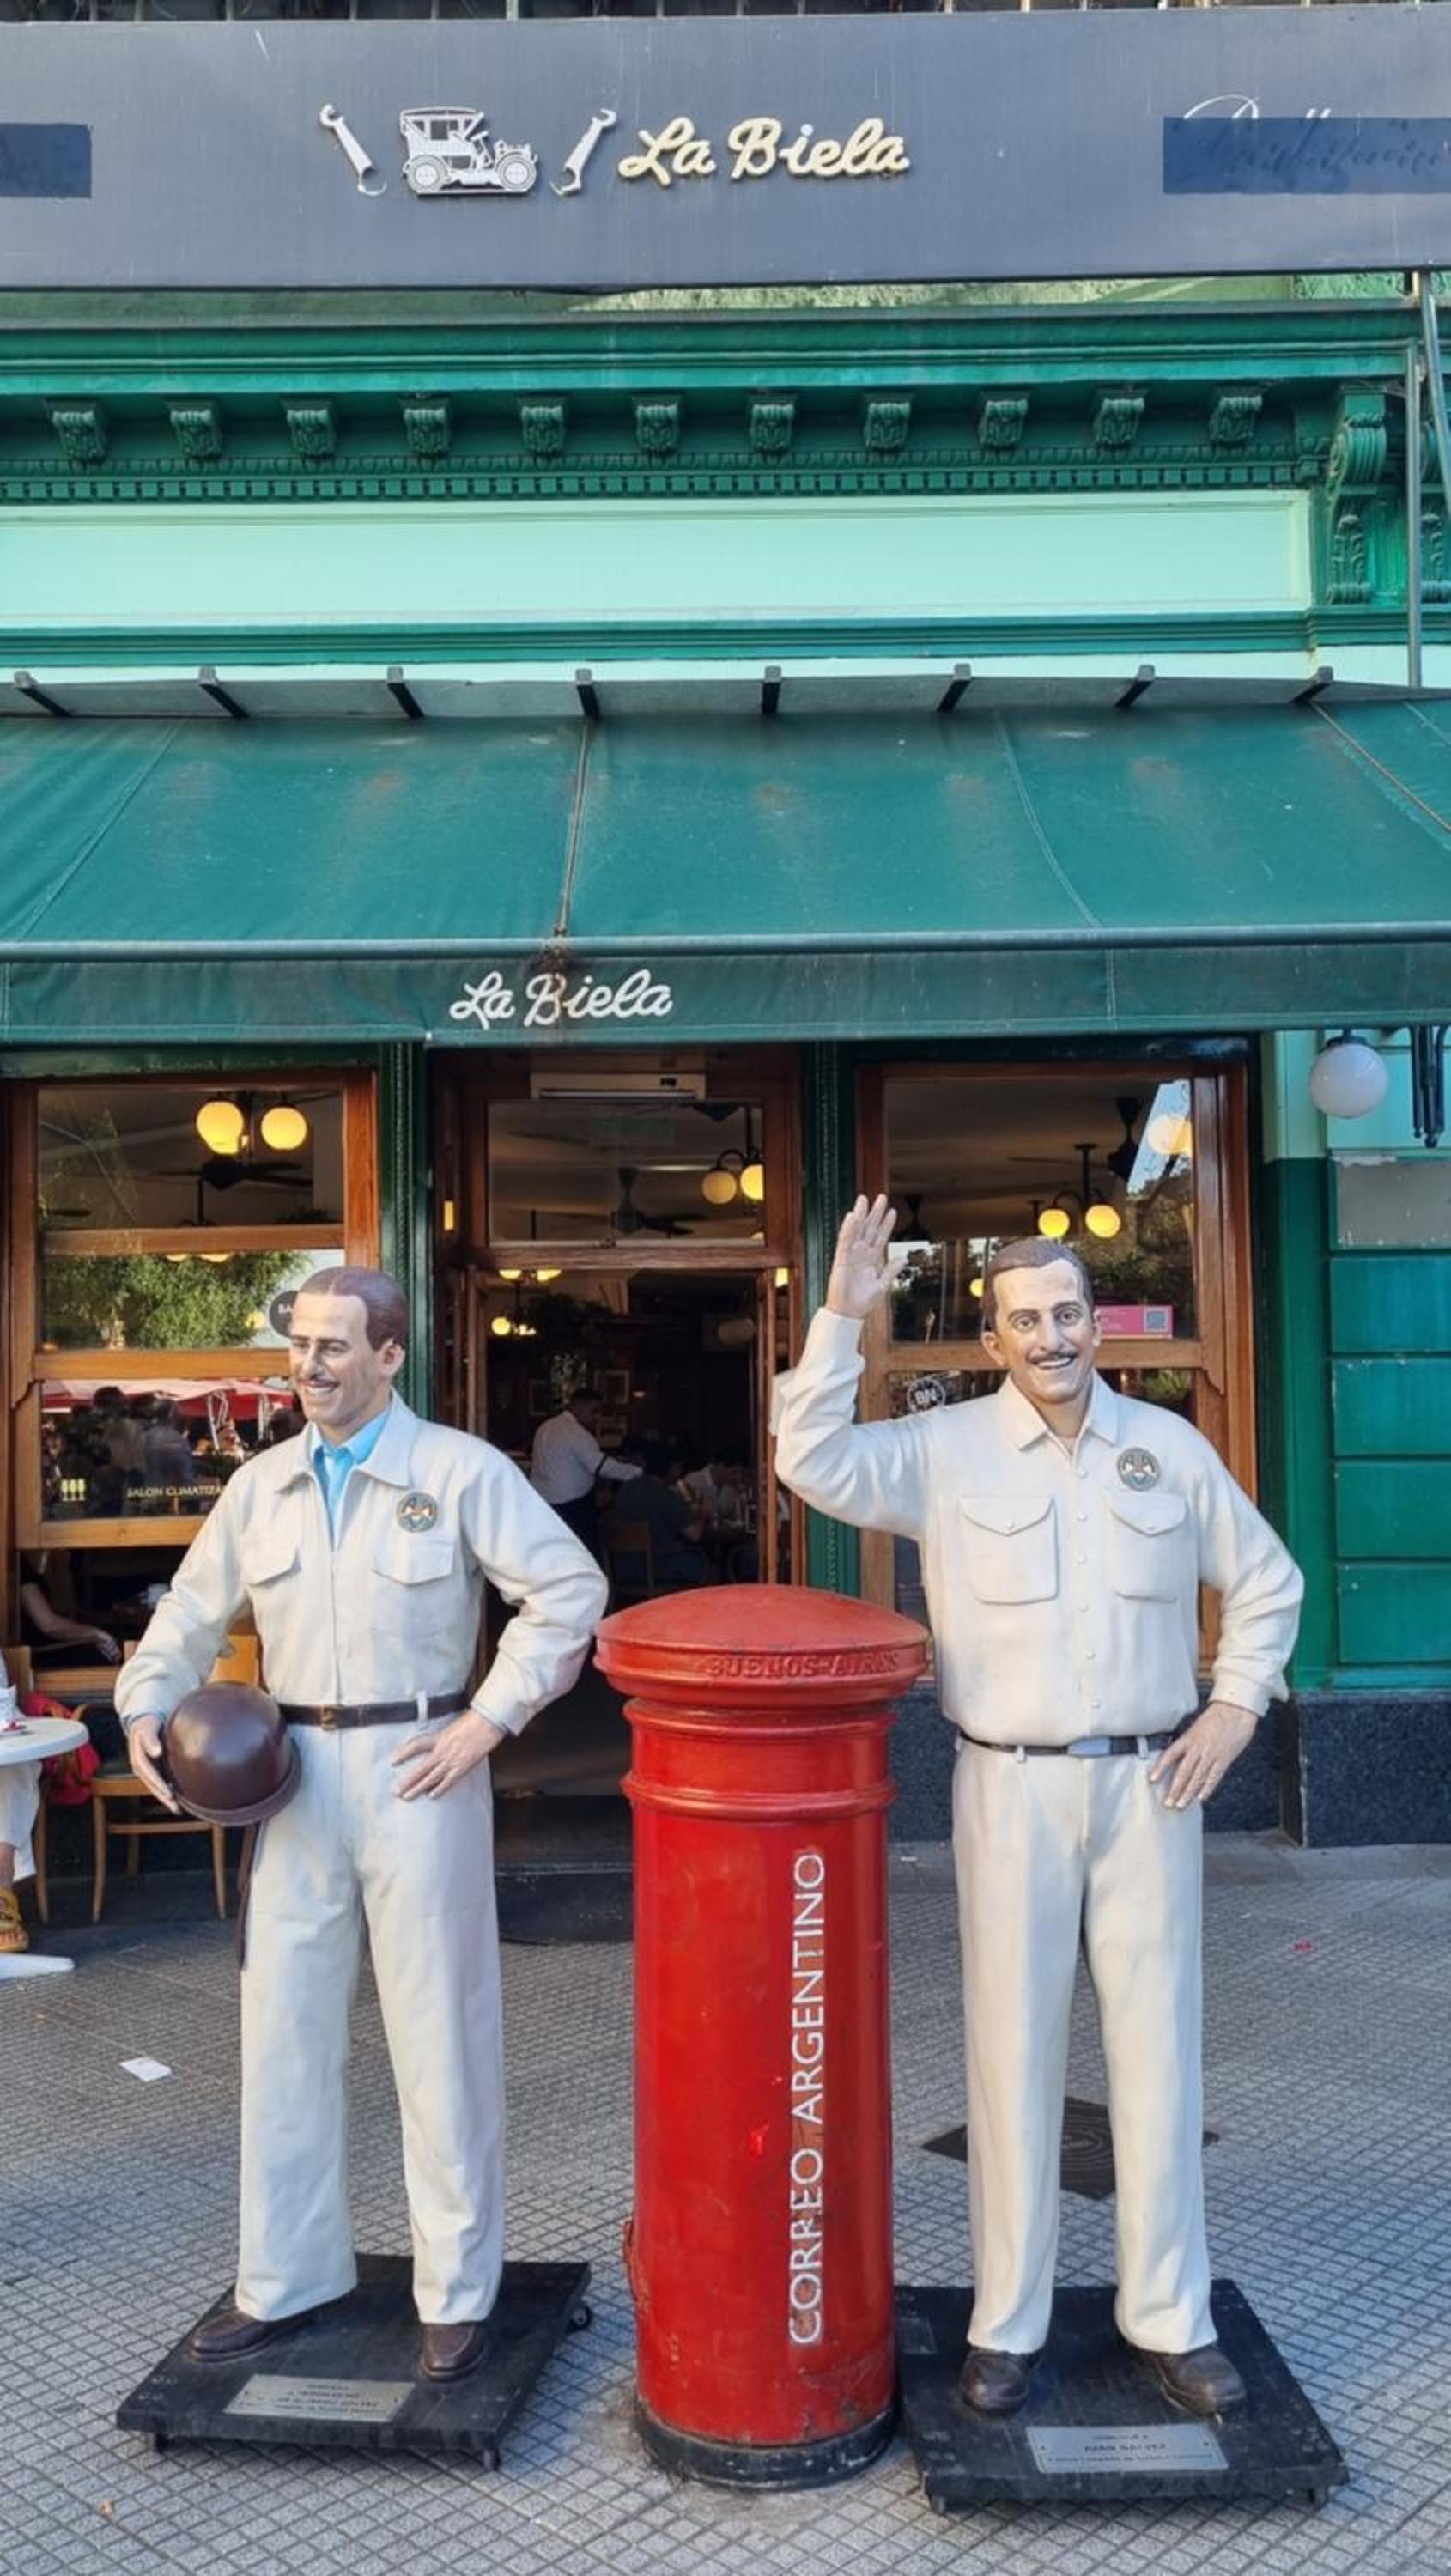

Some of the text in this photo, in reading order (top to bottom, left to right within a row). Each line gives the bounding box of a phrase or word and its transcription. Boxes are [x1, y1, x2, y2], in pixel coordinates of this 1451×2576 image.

[618, 116, 911, 185] La Biela
[449, 969, 673, 1030] La Biela
[165, 1485, 223, 1497] CLIMATIZA
[789, 1853, 825, 2343] CORREO ARGENTINO
